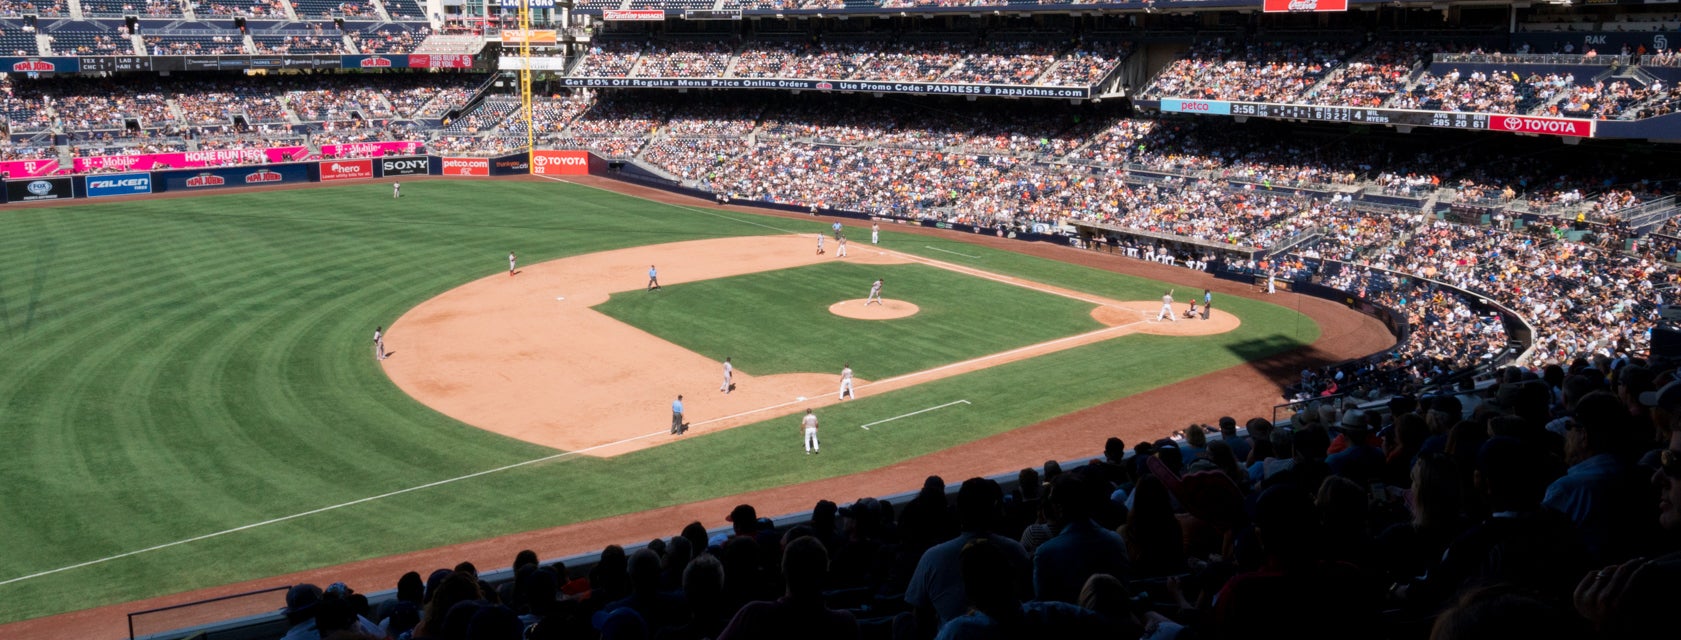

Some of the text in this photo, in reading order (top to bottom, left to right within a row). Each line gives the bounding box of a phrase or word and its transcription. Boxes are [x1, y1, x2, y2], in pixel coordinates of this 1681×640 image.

[1585, 35, 1607, 44] RAK
[633, 79, 674, 87] Regular
[861, 82, 892, 90] Promo
[926, 85, 980, 93] PADRES5
[995, 87, 1082, 97] papajohns.com
[1181, 100, 1209, 111] petco
[1233, 105, 1254, 114] 3:56
[1354, 111, 1361, 120] 4
[1430, 118, 1450, 126] .285
[1455, 120, 1467, 128] 20
[1524, 120, 1576, 133] TOYOTA
[185, 151, 217, 162] HOME
[217, 150, 239, 160] RUN
[384, 160, 427, 170] SONY
[443, 160, 487, 168] petco.com
[548, 157, 586, 165] TOYOTA
[24, 162, 36, 174] T
[338, 164, 360, 173] hero
[188, 176, 203, 186] PAPA
[247, 173, 261, 182] PAPA
